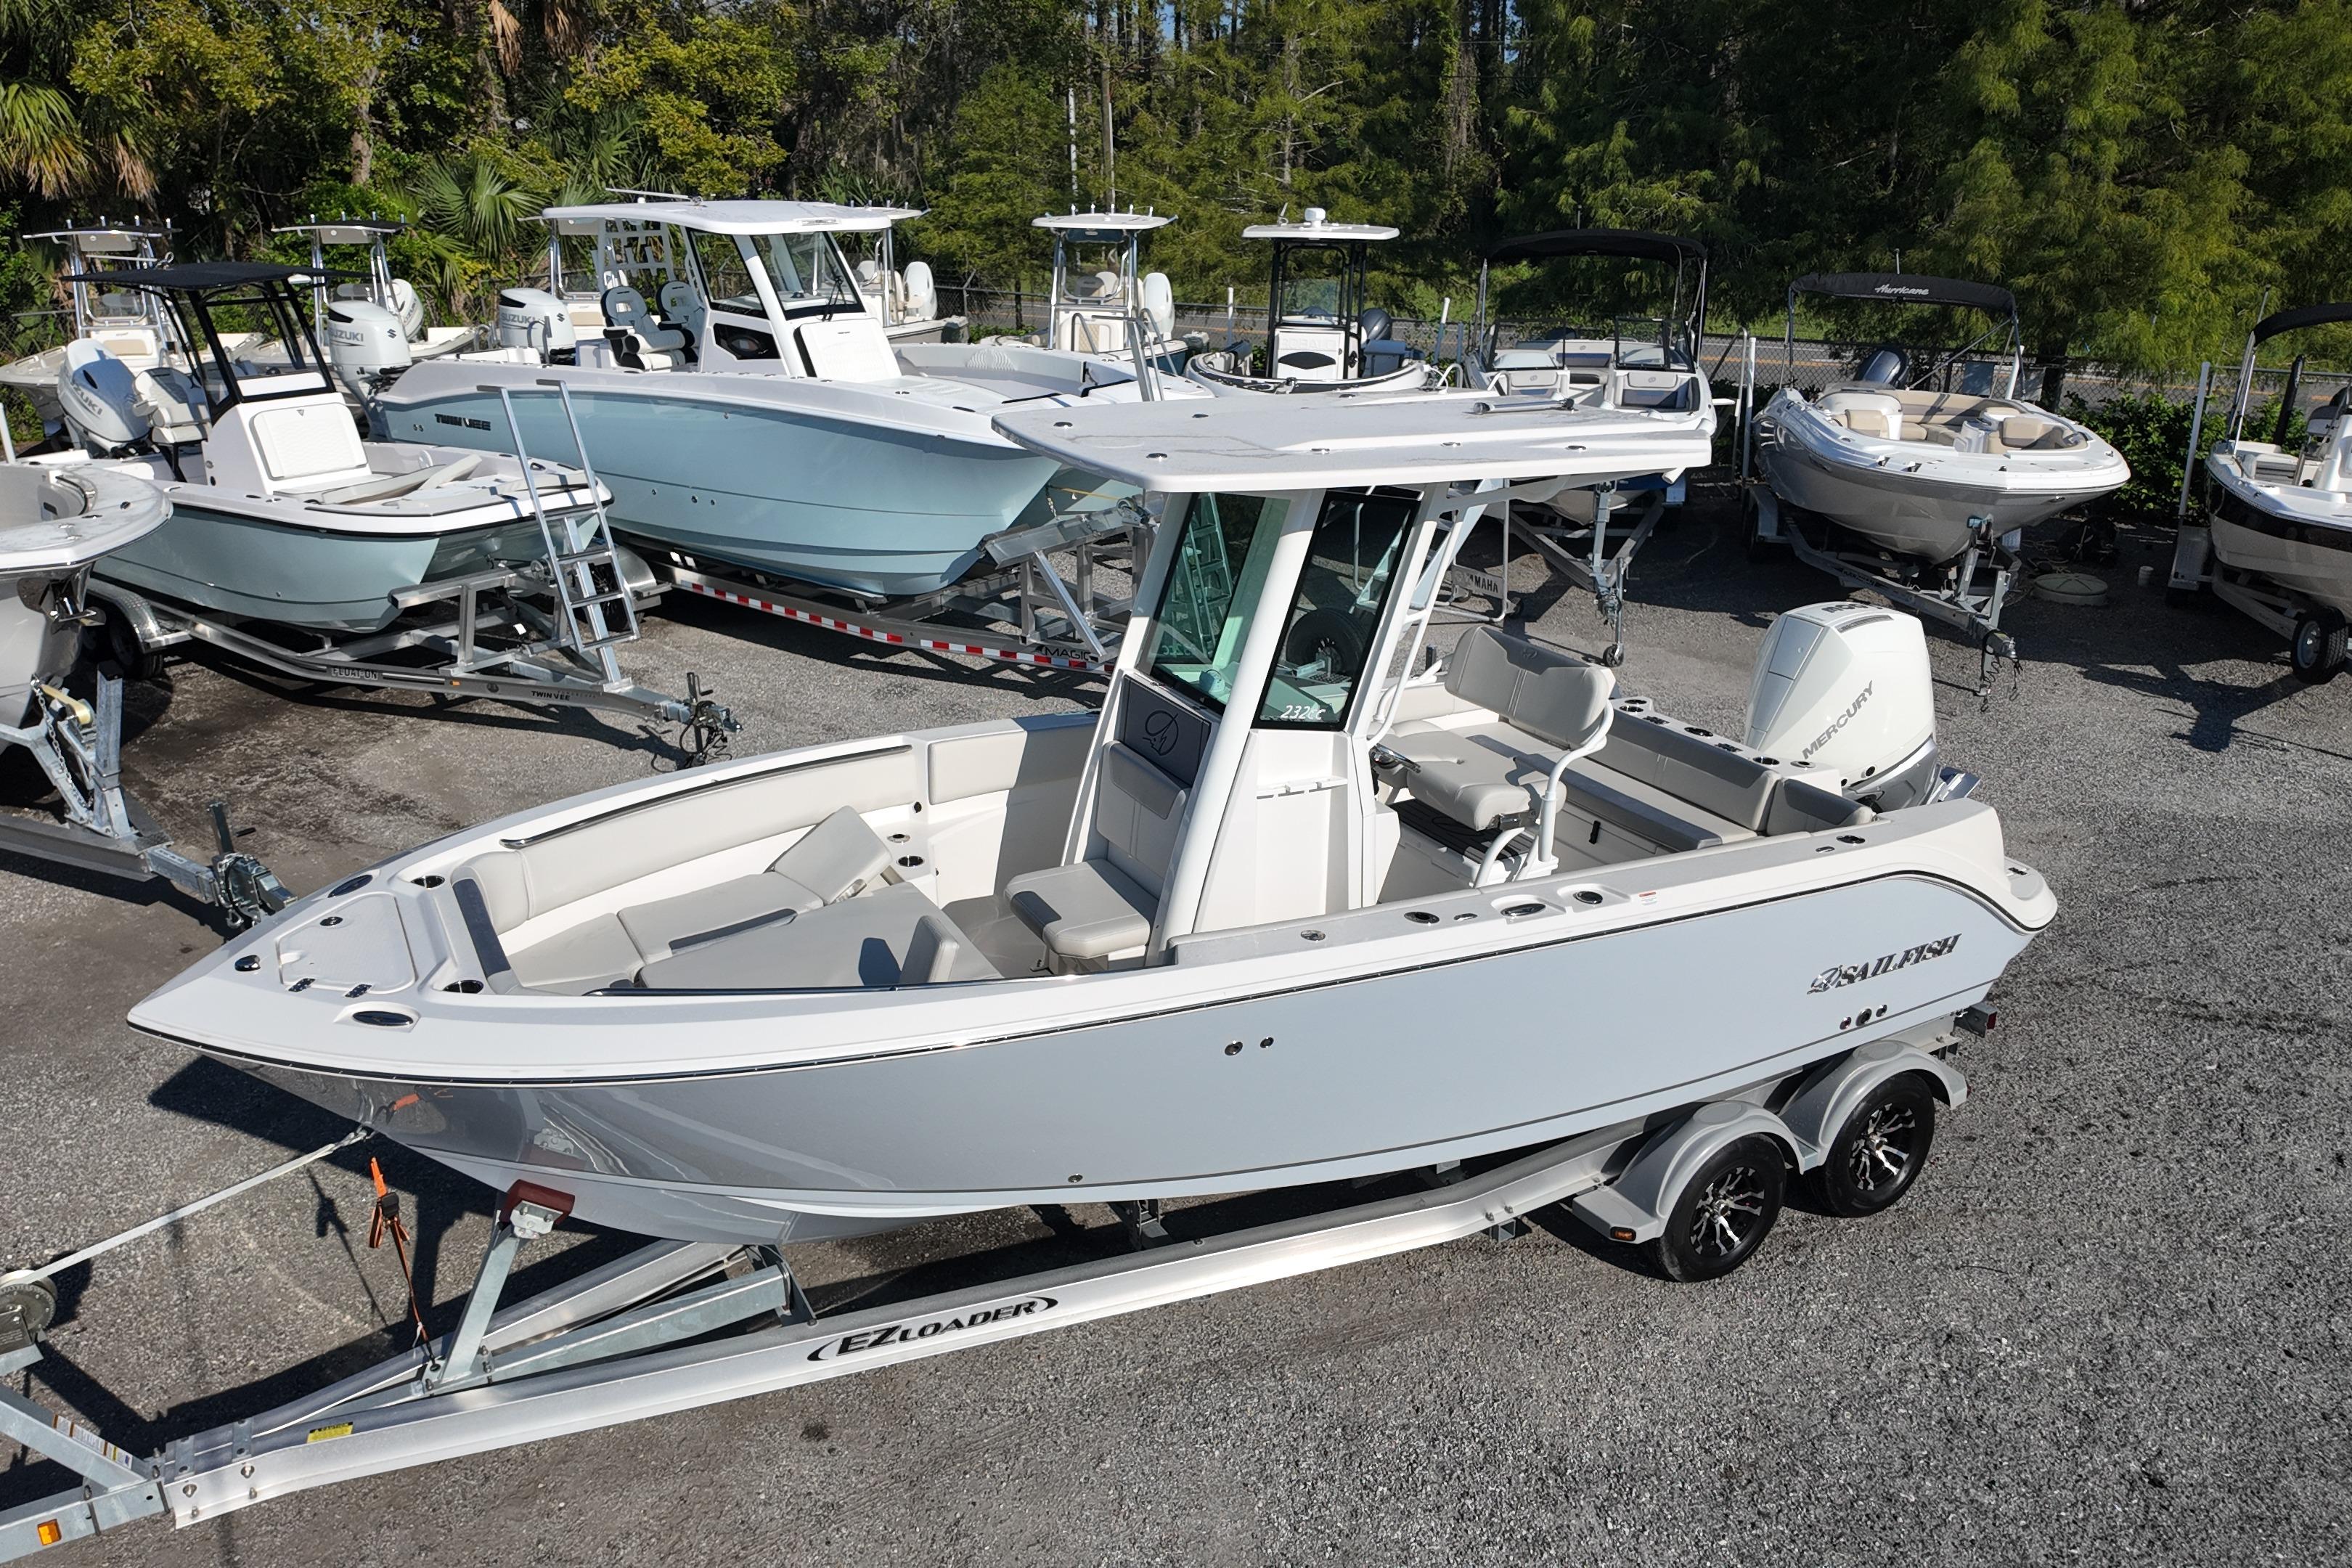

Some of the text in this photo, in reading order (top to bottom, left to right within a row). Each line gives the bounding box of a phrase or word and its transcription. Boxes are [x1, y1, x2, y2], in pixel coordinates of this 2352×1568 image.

[1874, 284, 1930, 295] Hurricane
[531, 690, 552, 698] TWIN
[553, 691, 571, 701] VEE
[1802, 679, 1873, 760] MERCURY
[1834, 933, 1963, 989] SAILFISH
